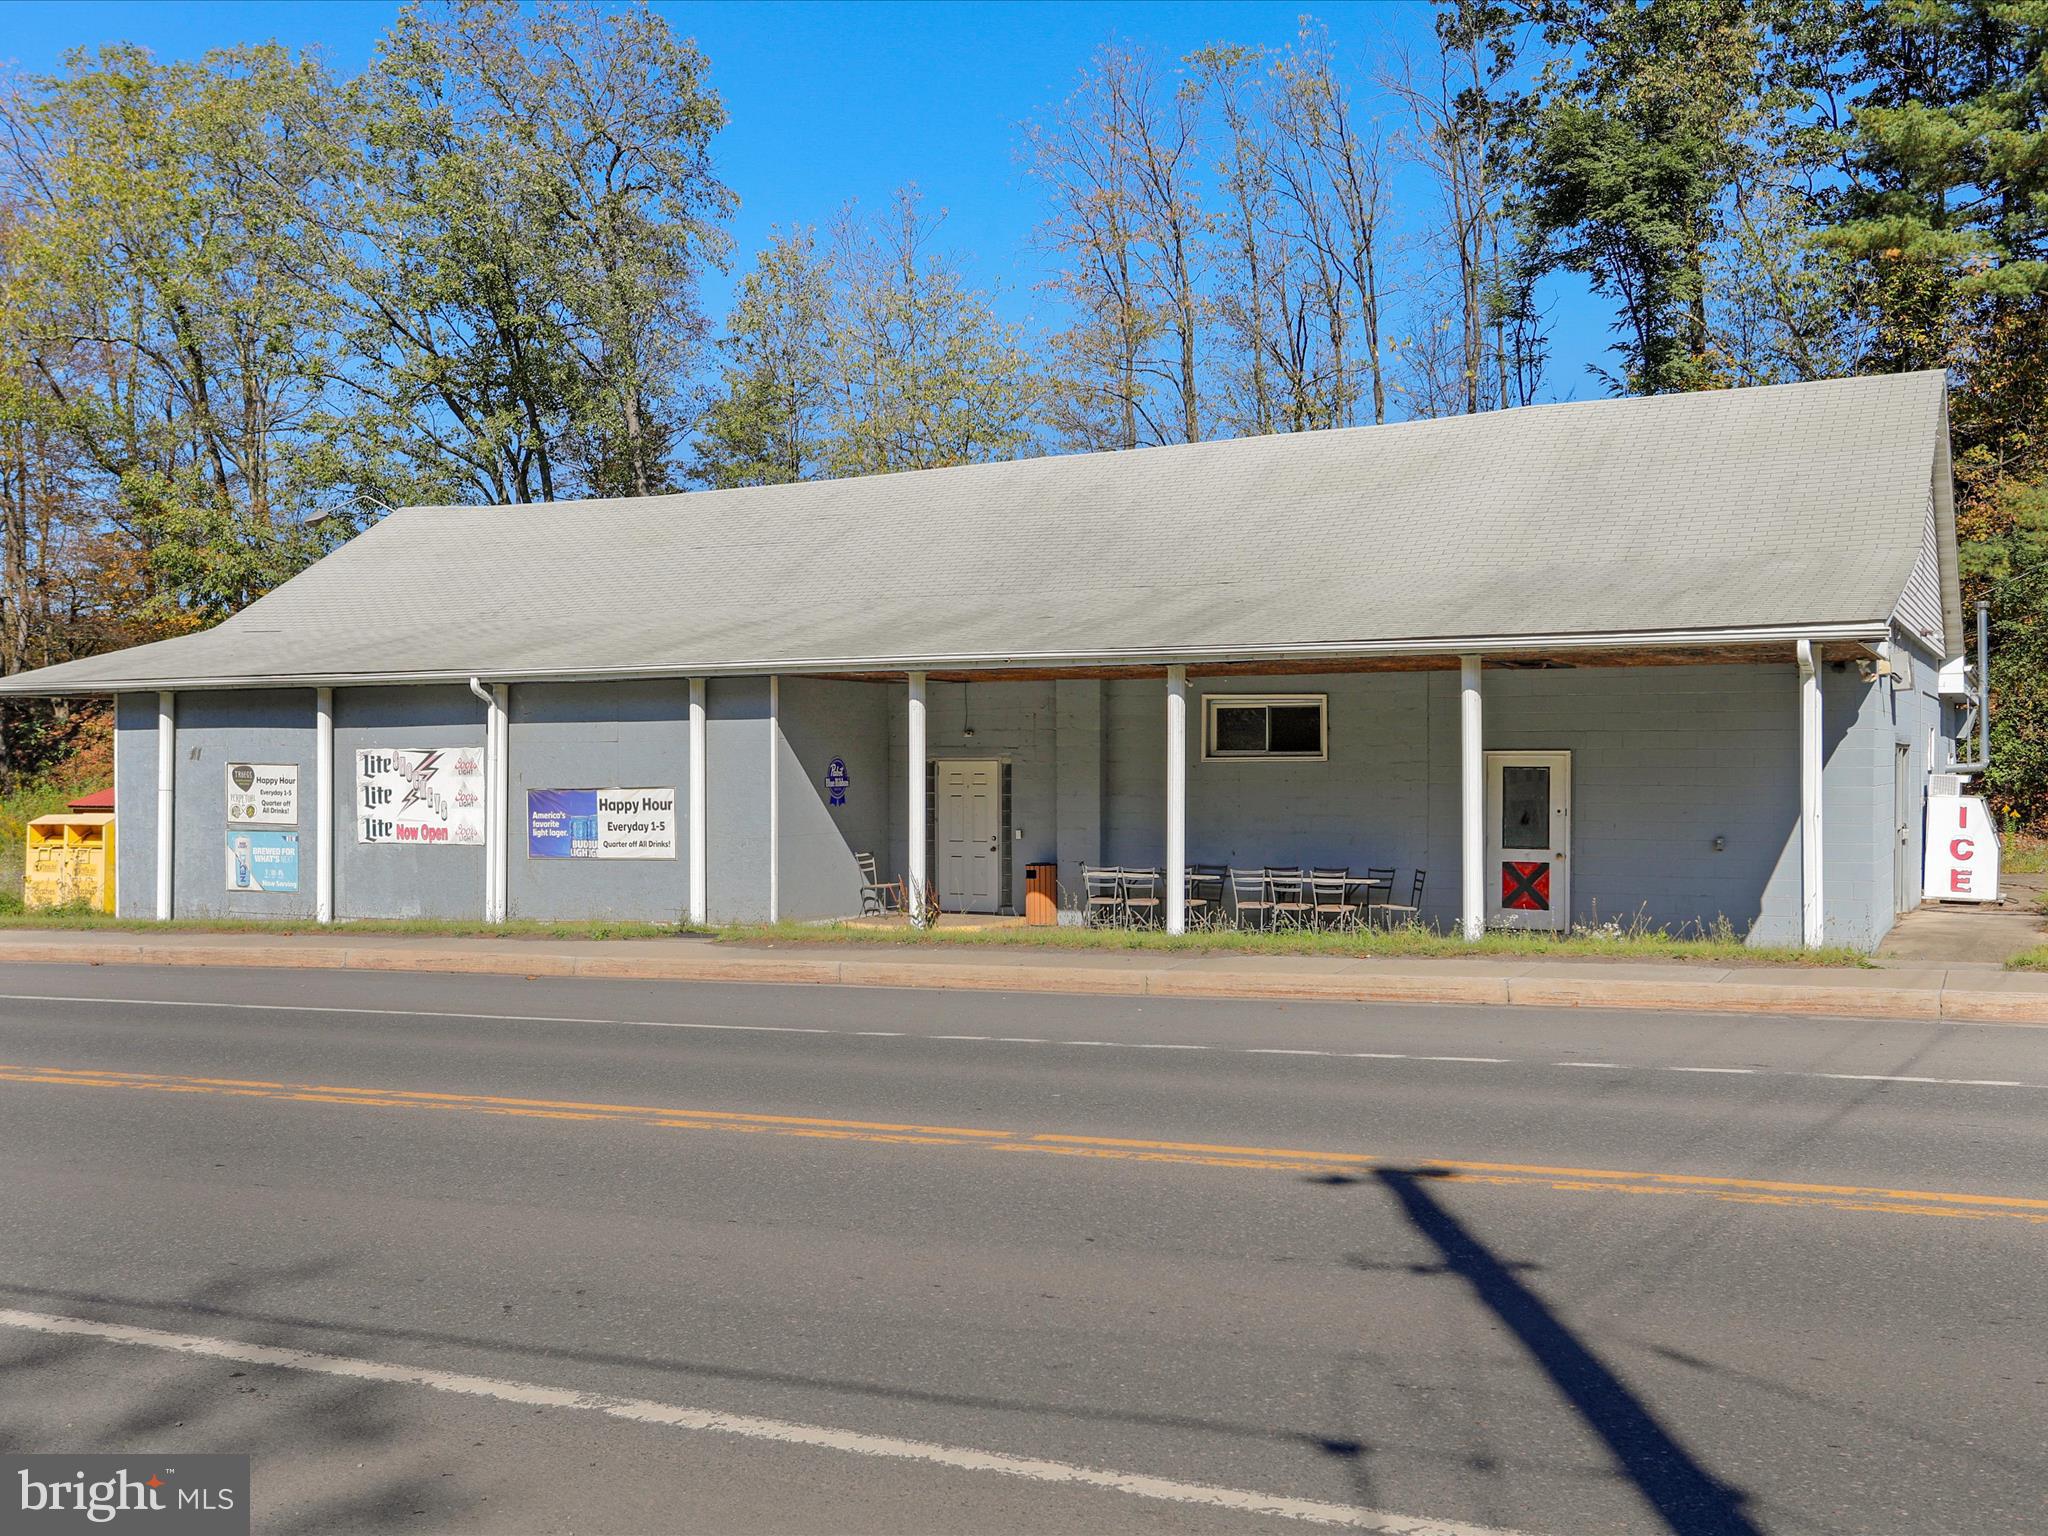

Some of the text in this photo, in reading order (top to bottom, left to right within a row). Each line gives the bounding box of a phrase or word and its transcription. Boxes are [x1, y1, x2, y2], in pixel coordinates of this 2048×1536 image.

[363, 754, 392, 778] Lite
[455, 757, 478, 770] Coors
[256, 776, 278, 785] Happy
[279, 776, 296, 784] Hour
[364, 785, 393, 810] Lite
[455, 789, 478, 802] Coors
[261, 799, 282, 807] Quarter
[598, 797, 673, 814] Happy Hour
[532, 811, 566, 820] America's
[365, 817, 393, 842] Lite
[532, 819, 560, 828] favorite
[607, 821, 666, 834] Everyday 1-5
[396, 823, 449, 843] Now Open
[532, 828, 569, 838] light lager.
[252, 847, 296, 855] BREWED FOR
[603, 840, 671, 849] Quarter off All Drinks!
[1949, 806, 1975, 893] ICE
[255, 855, 280, 863] WHAT'S
